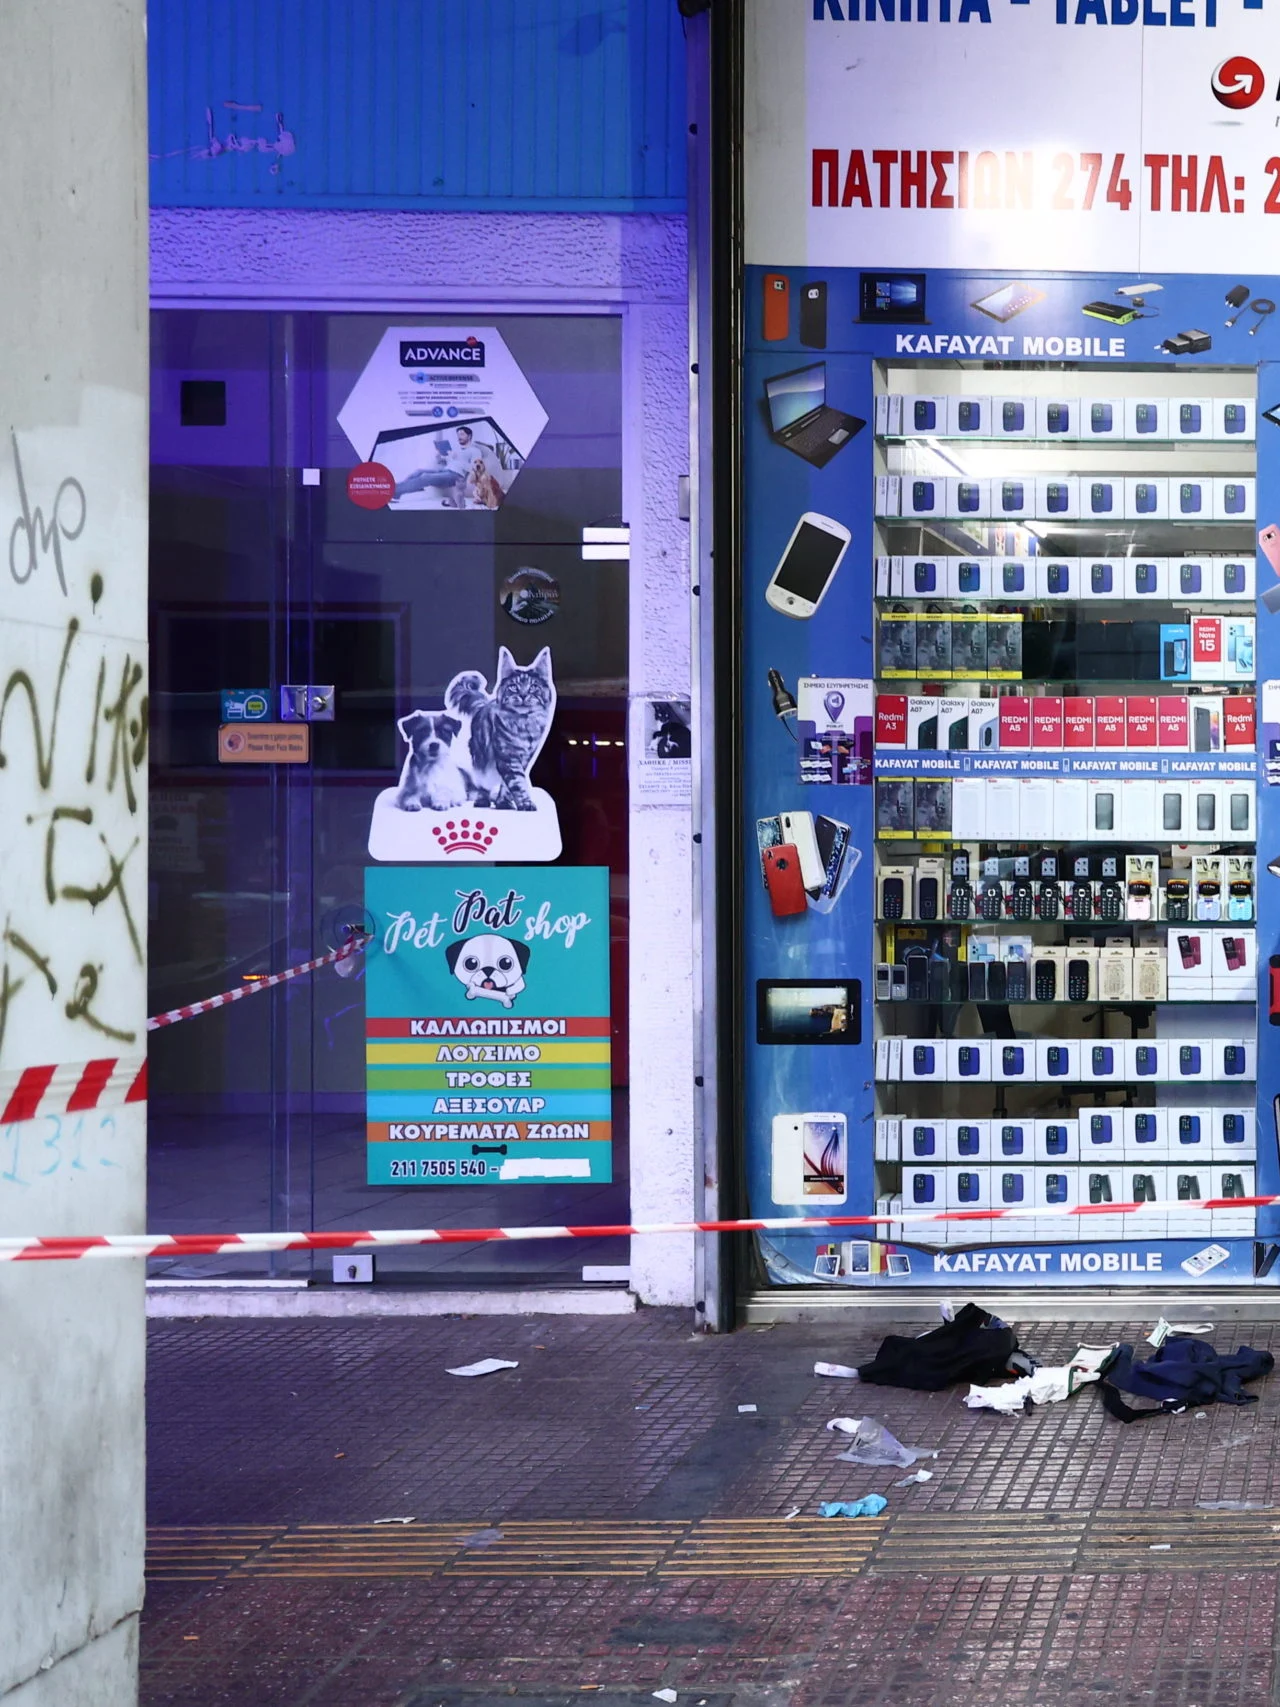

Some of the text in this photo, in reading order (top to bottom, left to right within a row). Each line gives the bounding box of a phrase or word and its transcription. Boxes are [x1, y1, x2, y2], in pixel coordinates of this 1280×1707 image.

[1051, 152, 1132, 211] 274
[1144, 154, 1245, 213] ΤΗΛ:
[895, 334, 1126, 358] KAFAYAT MOBILE
[404, 348, 481, 361] ADVANCE
[1199, 639, 1216, 652] 15
[878, 712, 904, 721] Redmi
[1001, 716, 1028, 724] REDMI
[1034, 716, 1061, 724] REDMI
[1065, 716, 1092, 724] REDMI
[1097, 716, 1124, 724] REDMI
[1128, 716, 1155, 724] REDMI
[1160, 716, 1187, 724] REDMI
[1227, 714, 1253, 723] Redmi
[885, 722, 897, 731] A3
[1234, 723, 1246, 732] A3
[875, 759, 961, 769] KAFAYAT MOBILE
[974, 760, 1060, 770] KAFAYAT MOBILE
[1073, 761, 1159, 771] KAFAYAT MOBILE
[1171, 761, 1257, 771] KAFAYAT MOBILE
[383, 889, 592, 954] Pet Pat shop
[410, 1019, 566, 1036] ΚΑΛΛΩΠΙΣΜΟΙ
[436, 1045, 541, 1062] ΛΟΥΣΙΜΟ
[445, 1071, 532, 1088] ΤΡΟΦΕΣ
[432, 1097, 546, 1114] ΑΞΕΣΟΥΑΡ
[388, 1123, 590, 1140] ΚΟΥΡΕΜΑΤΑ ΖΩΩΝ
[390, 1160, 417, 1176] 211
[421, 1160, 456, 1176] 7505
[459, 1160, 486, 1176] 540
[934, 1252, 1163, 1273] KAFAYAT MOBILE
